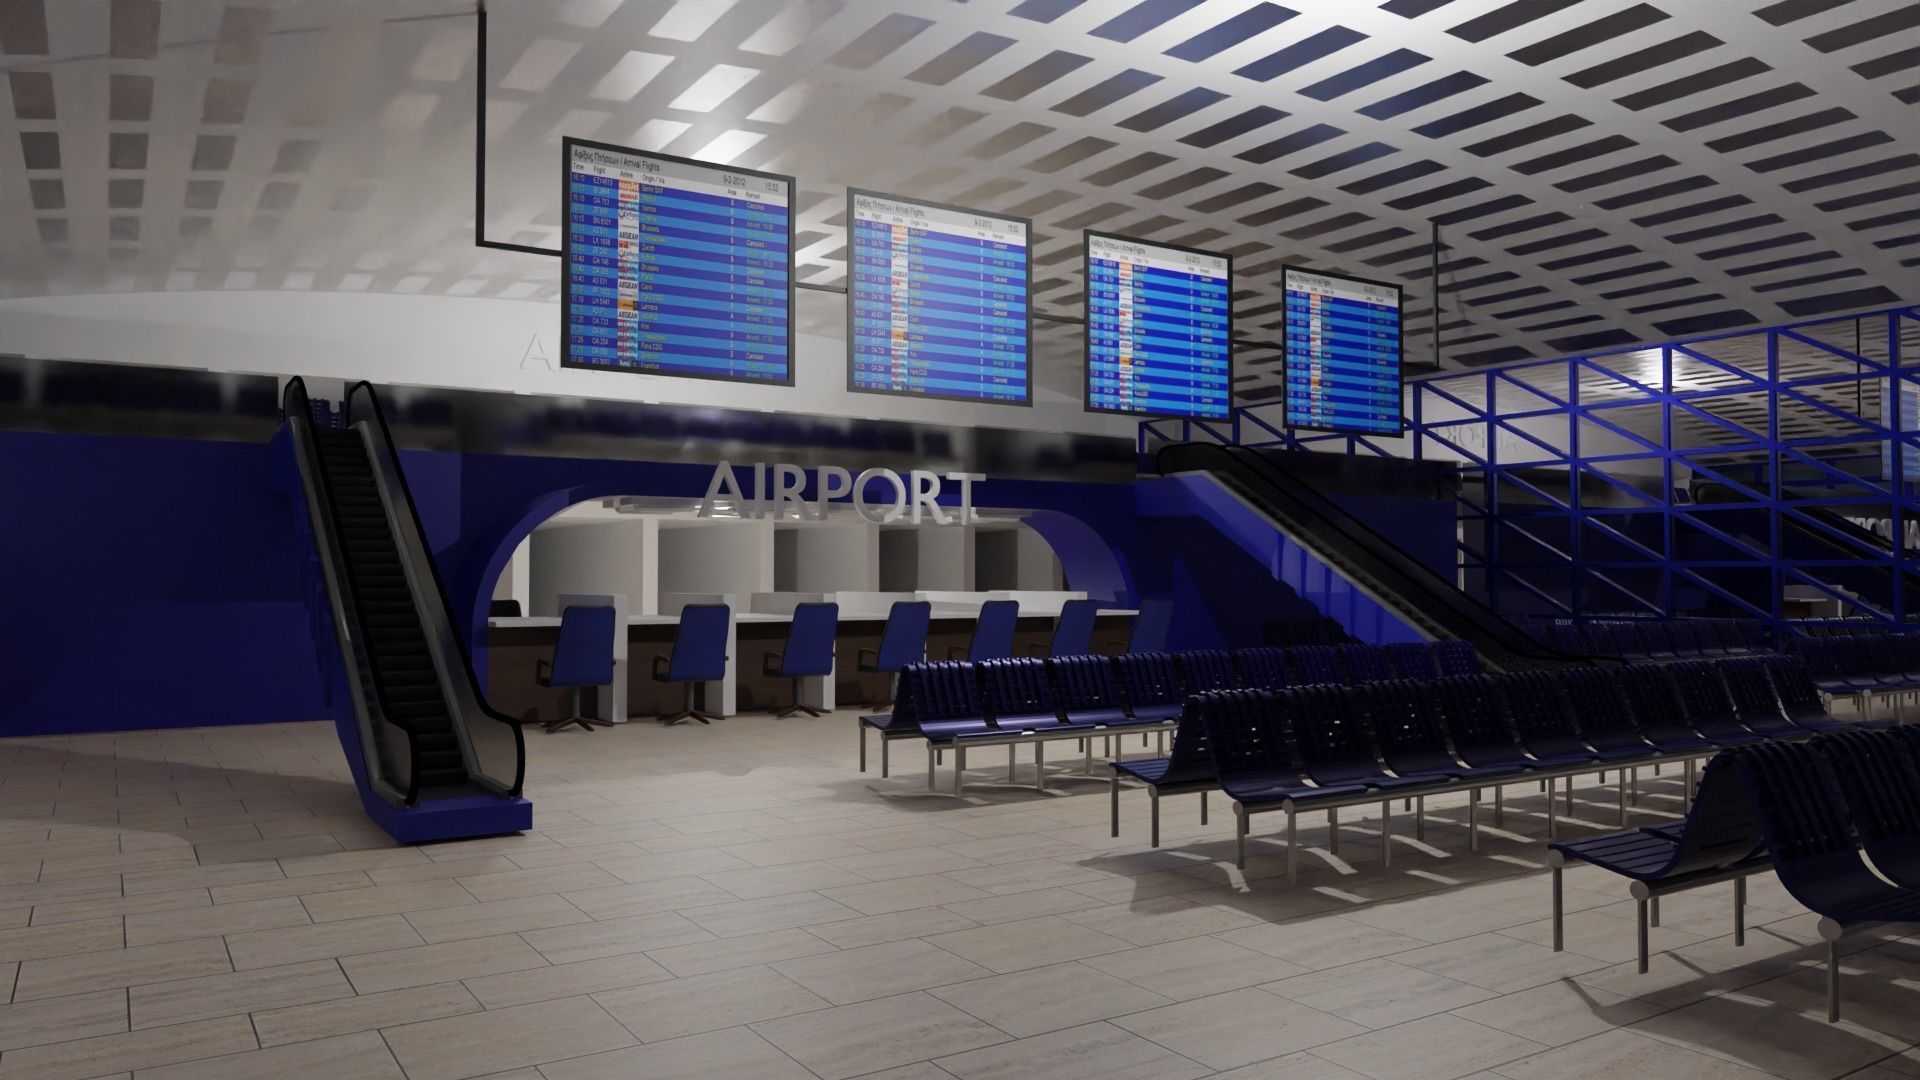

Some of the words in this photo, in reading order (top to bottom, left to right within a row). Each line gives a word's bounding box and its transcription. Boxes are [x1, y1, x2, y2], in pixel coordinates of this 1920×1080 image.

[594, 165, 605, 175] Flight
[642, 161, 660, 173] Flights
[697, 460, 986, 525] AIRPORT
